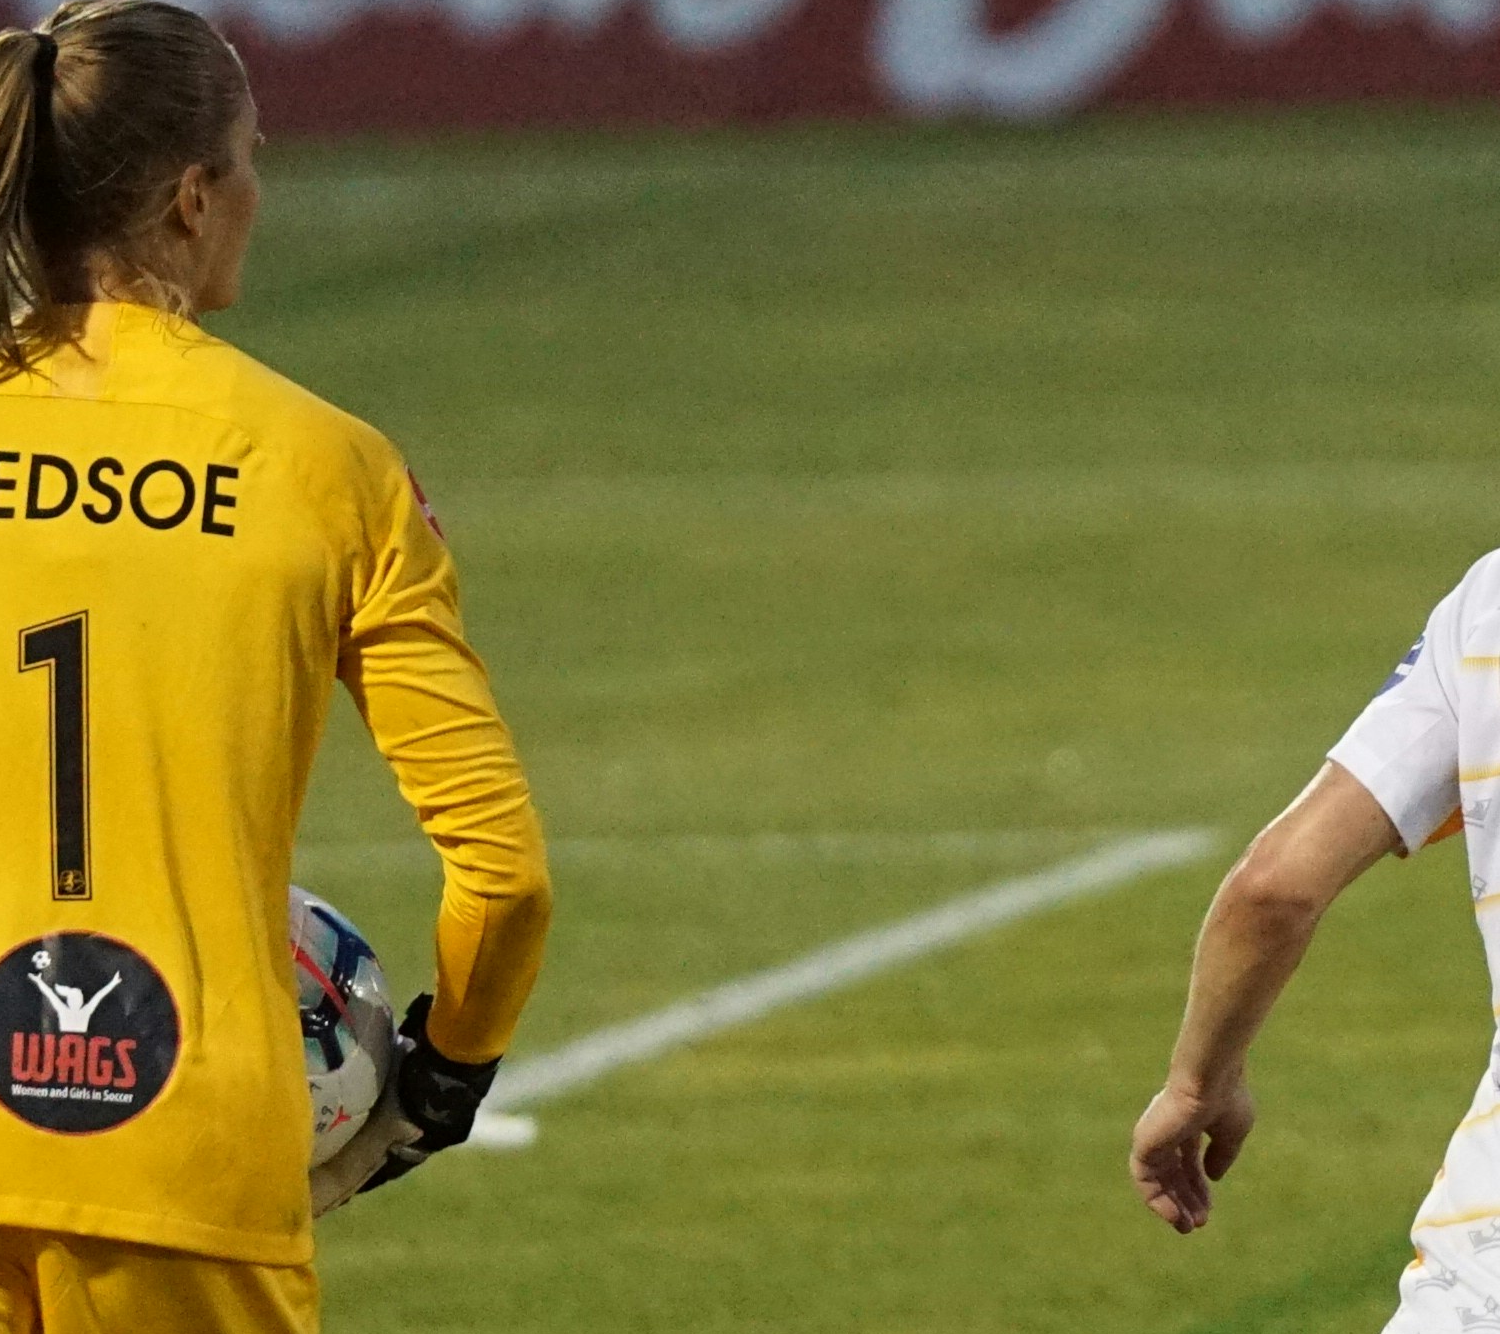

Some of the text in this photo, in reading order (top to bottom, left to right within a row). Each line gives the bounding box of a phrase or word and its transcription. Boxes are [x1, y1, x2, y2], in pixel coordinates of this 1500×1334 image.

[17, 609, 92, 902] 1
[11, 1031, 137, 1088] WAGS
[11, 1084, 134, 1103] Women and Girls in Soccer
